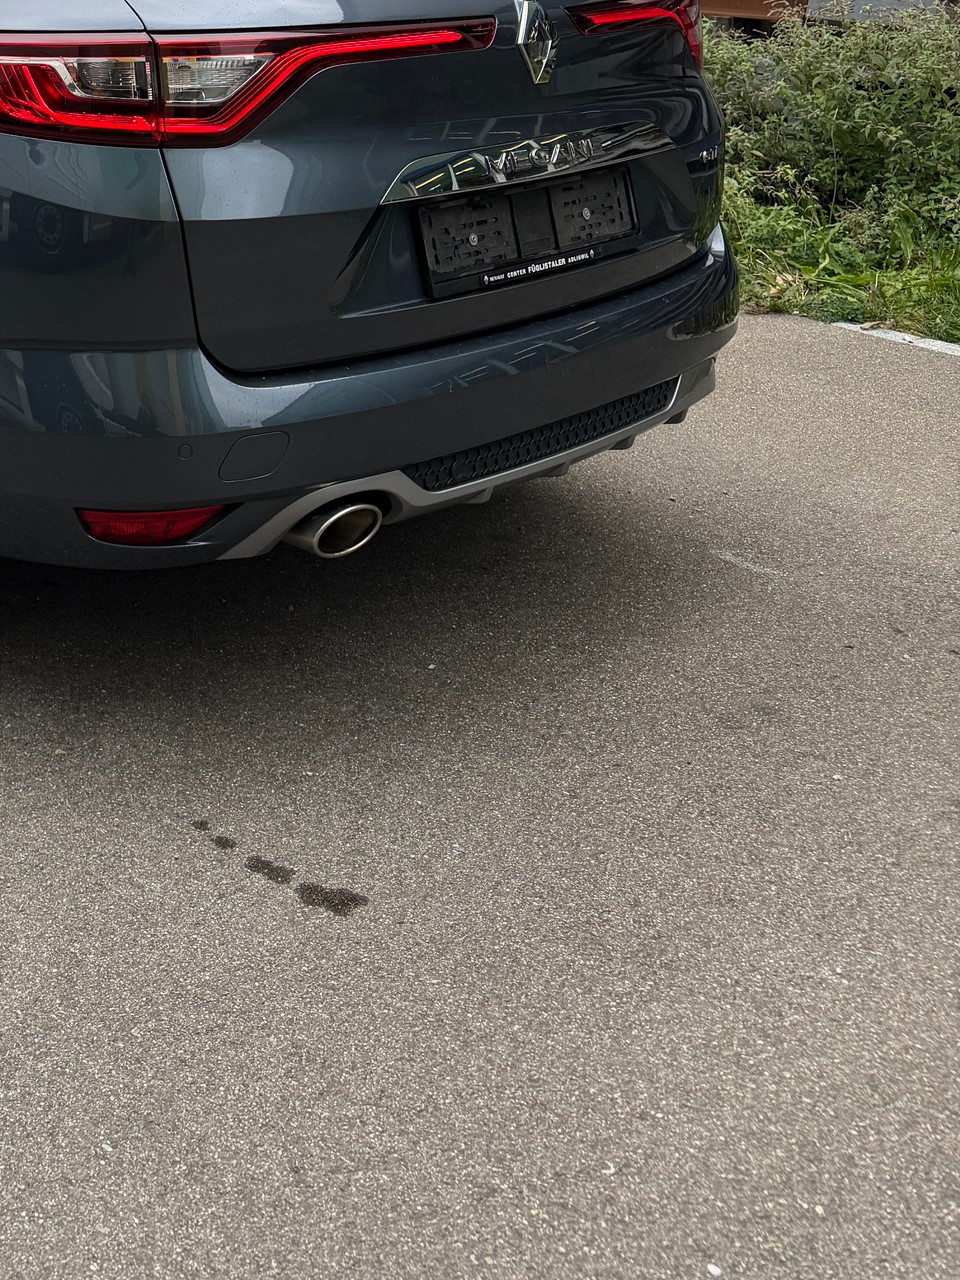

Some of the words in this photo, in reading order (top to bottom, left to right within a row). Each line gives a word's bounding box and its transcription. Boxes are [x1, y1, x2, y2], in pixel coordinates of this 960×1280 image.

[484, 138, 604, 173] MEGANE
[506, 268, 527, 279] CENTER
[527, 258, 567, 274] FÜGLISTALER
